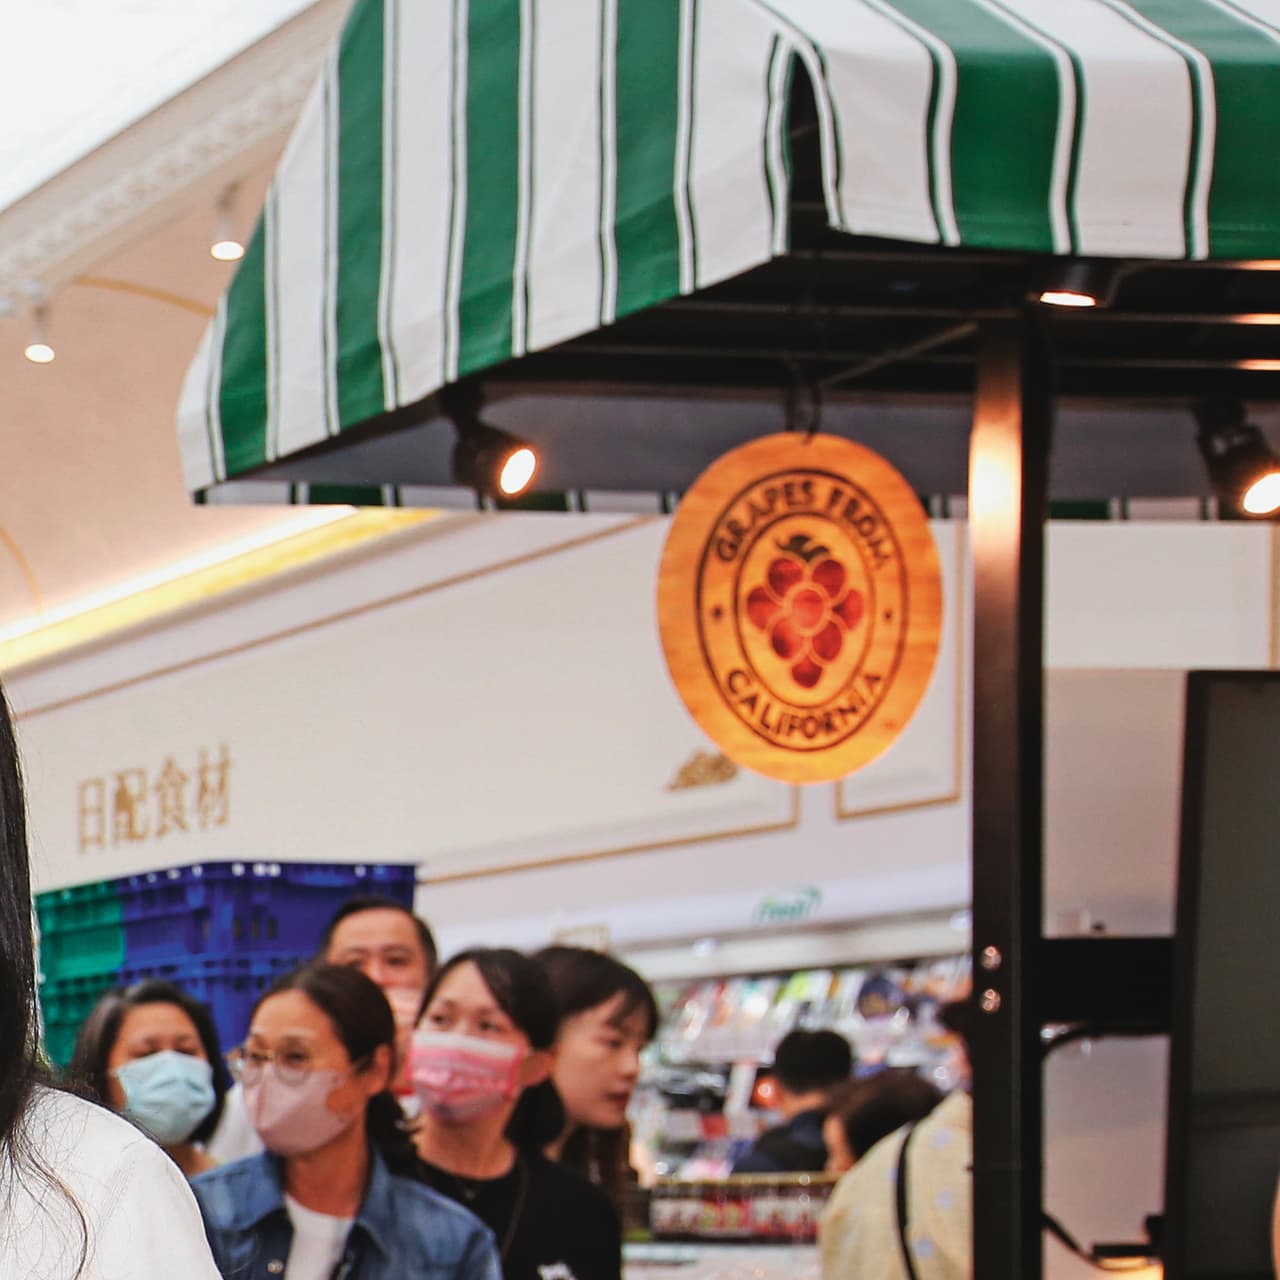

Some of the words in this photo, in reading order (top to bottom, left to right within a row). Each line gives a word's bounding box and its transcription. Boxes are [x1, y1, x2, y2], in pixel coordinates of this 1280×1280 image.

[717, 479, 814, 563] GRAPES
[826, 486, 893, 571] FROM
[726, 668, 882, 740] CALIFORNIA
[77, 742, 233, 853] 日配食材
